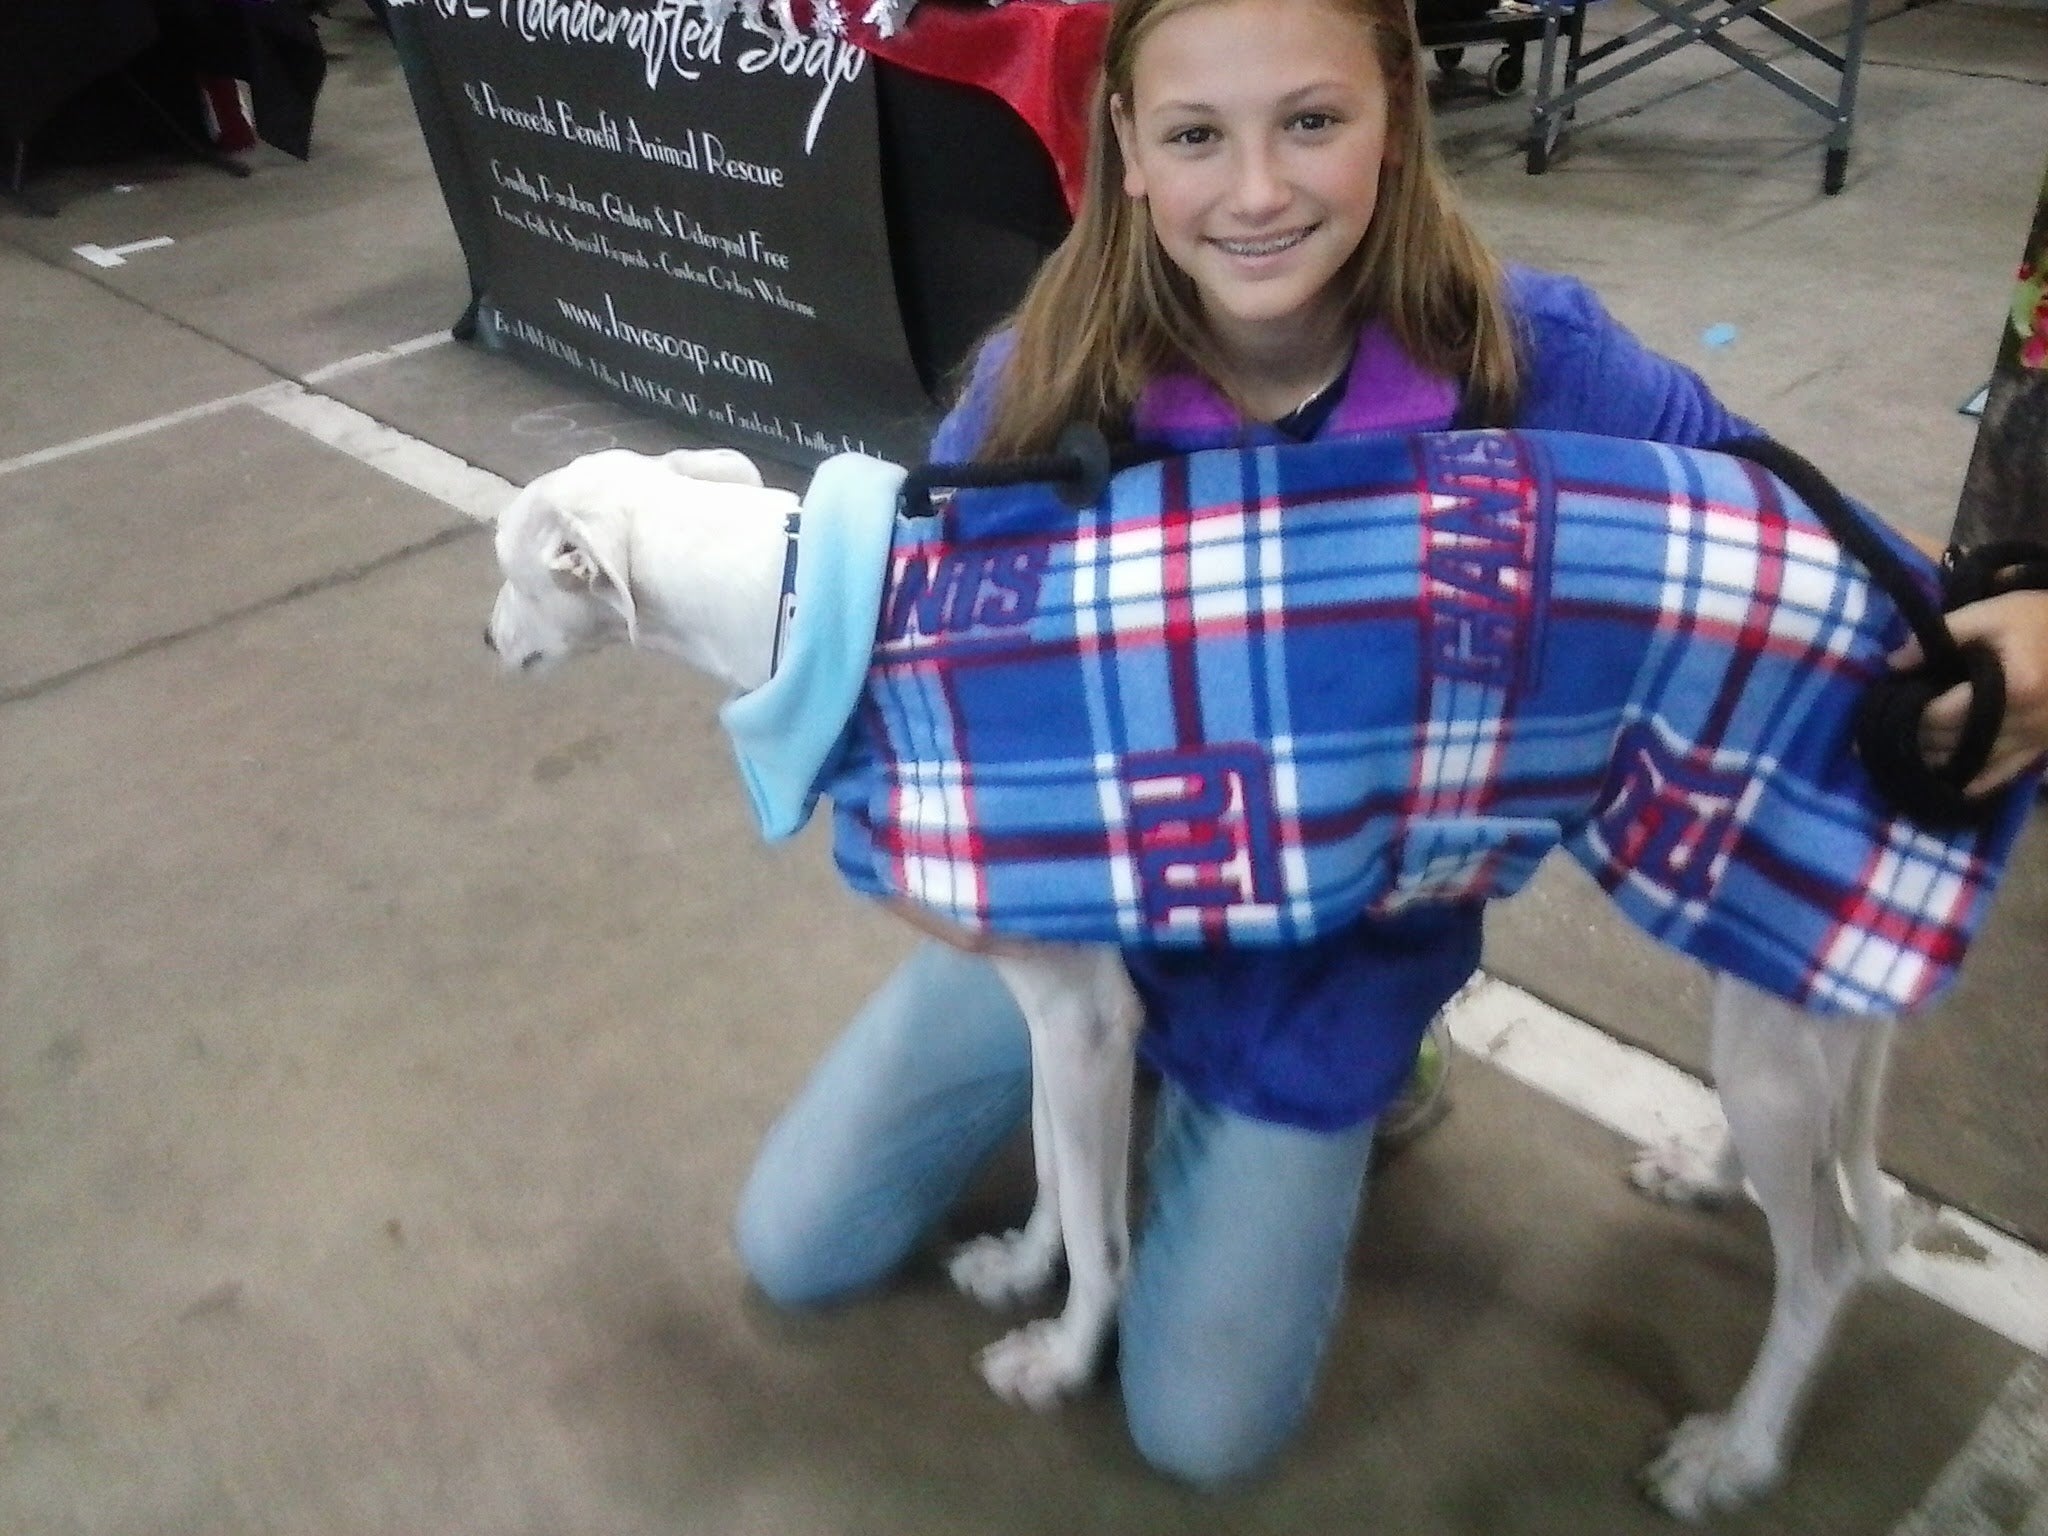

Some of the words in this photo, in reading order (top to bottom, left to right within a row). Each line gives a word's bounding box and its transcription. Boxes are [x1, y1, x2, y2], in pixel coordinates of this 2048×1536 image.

[480, 80, 558, 137] Proceeds
[556, 99, 622, 153] Benefit
[625, 116, 699, 171] Animal
[702, 131, 785, 188] Rescue
[737, 18, 867, 156] Soap
[749, 229, 790, 272] Free
